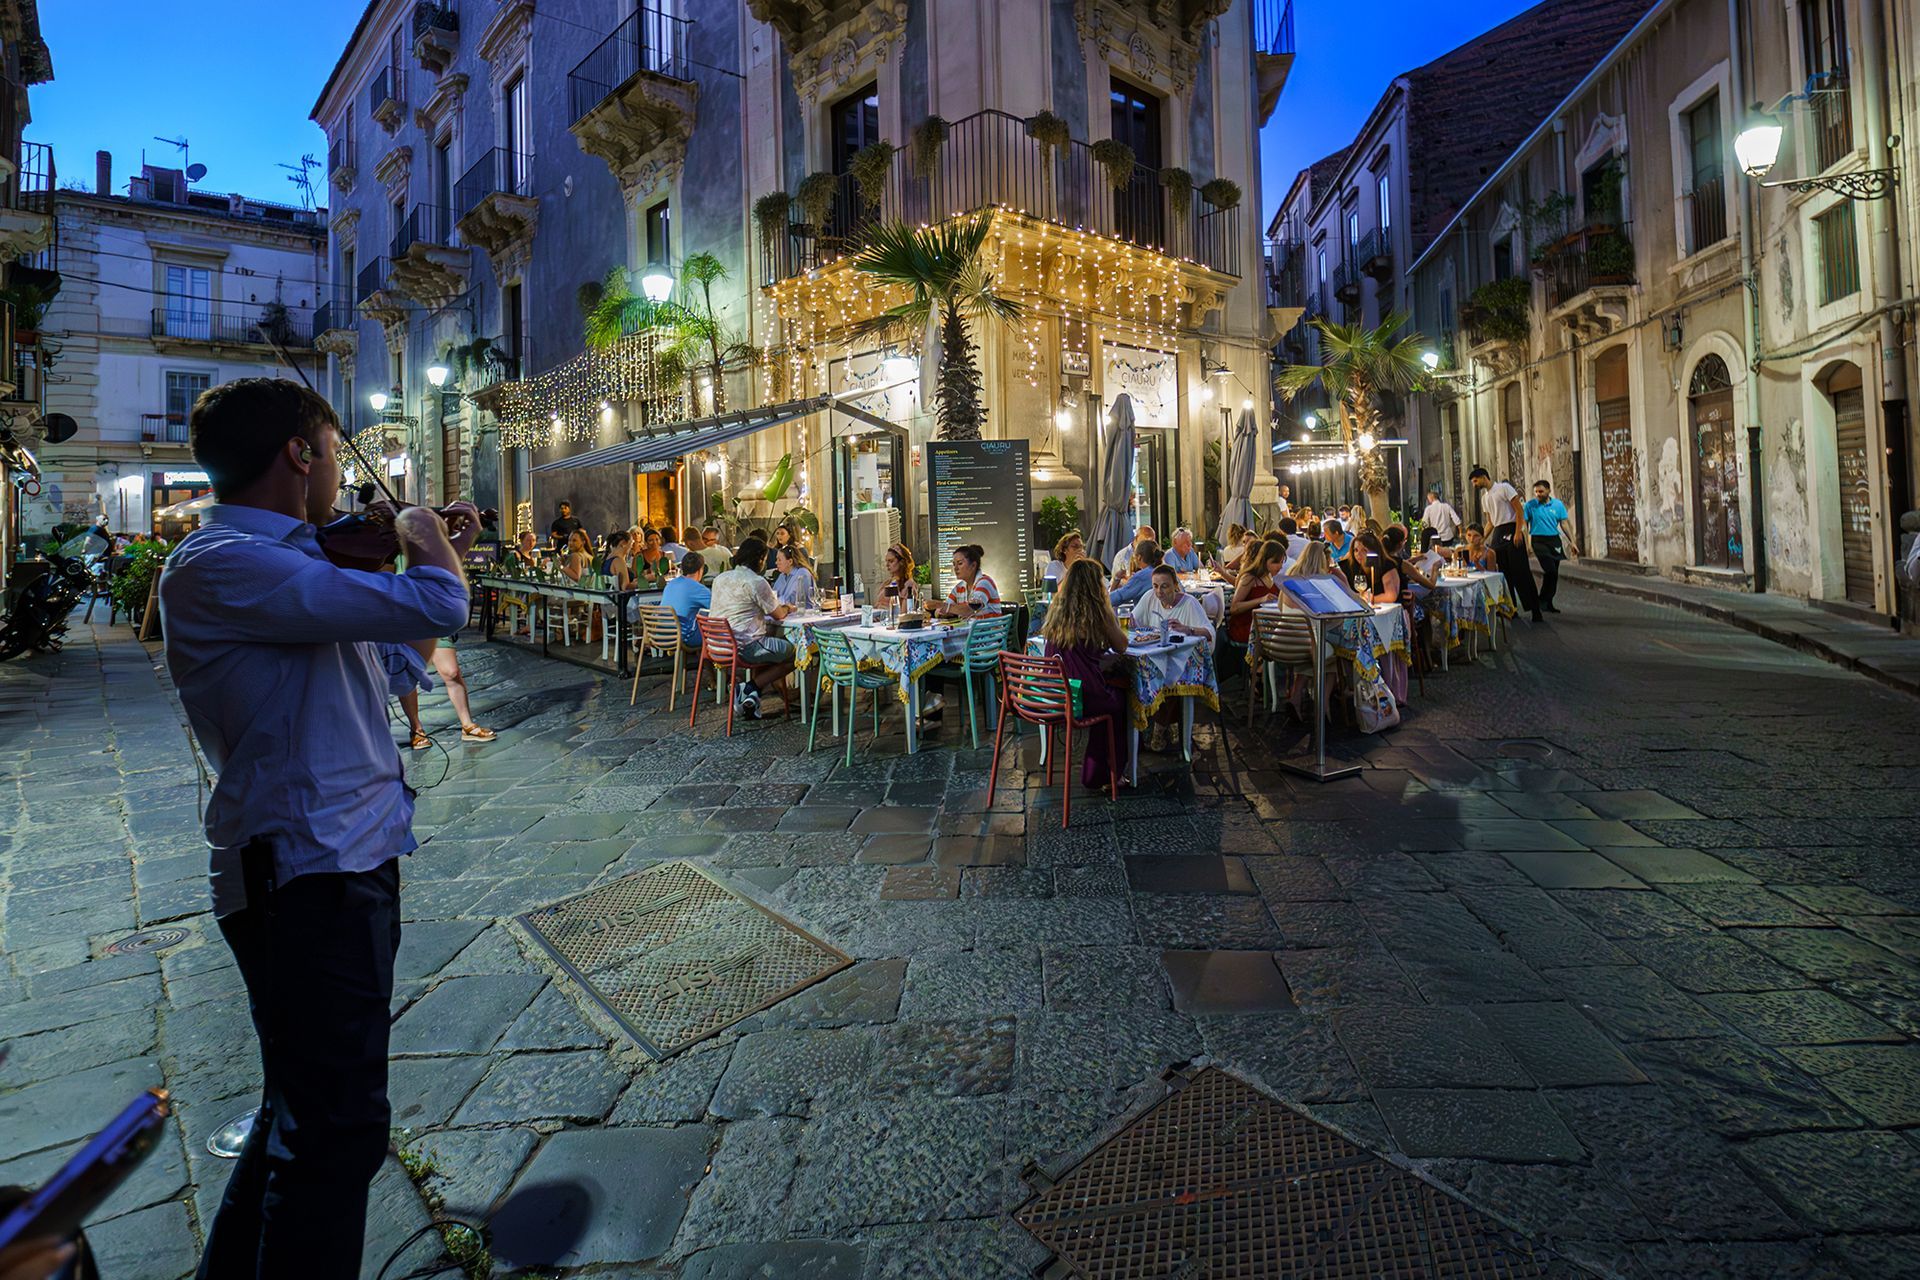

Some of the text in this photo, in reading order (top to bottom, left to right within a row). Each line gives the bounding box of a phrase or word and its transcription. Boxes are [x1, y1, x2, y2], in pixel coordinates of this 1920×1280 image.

[1121, 371, 1156, 386] CIAURU
[980, 442, 1011, 450] CIAURU
[655, 970, 714, 1003] SIP
